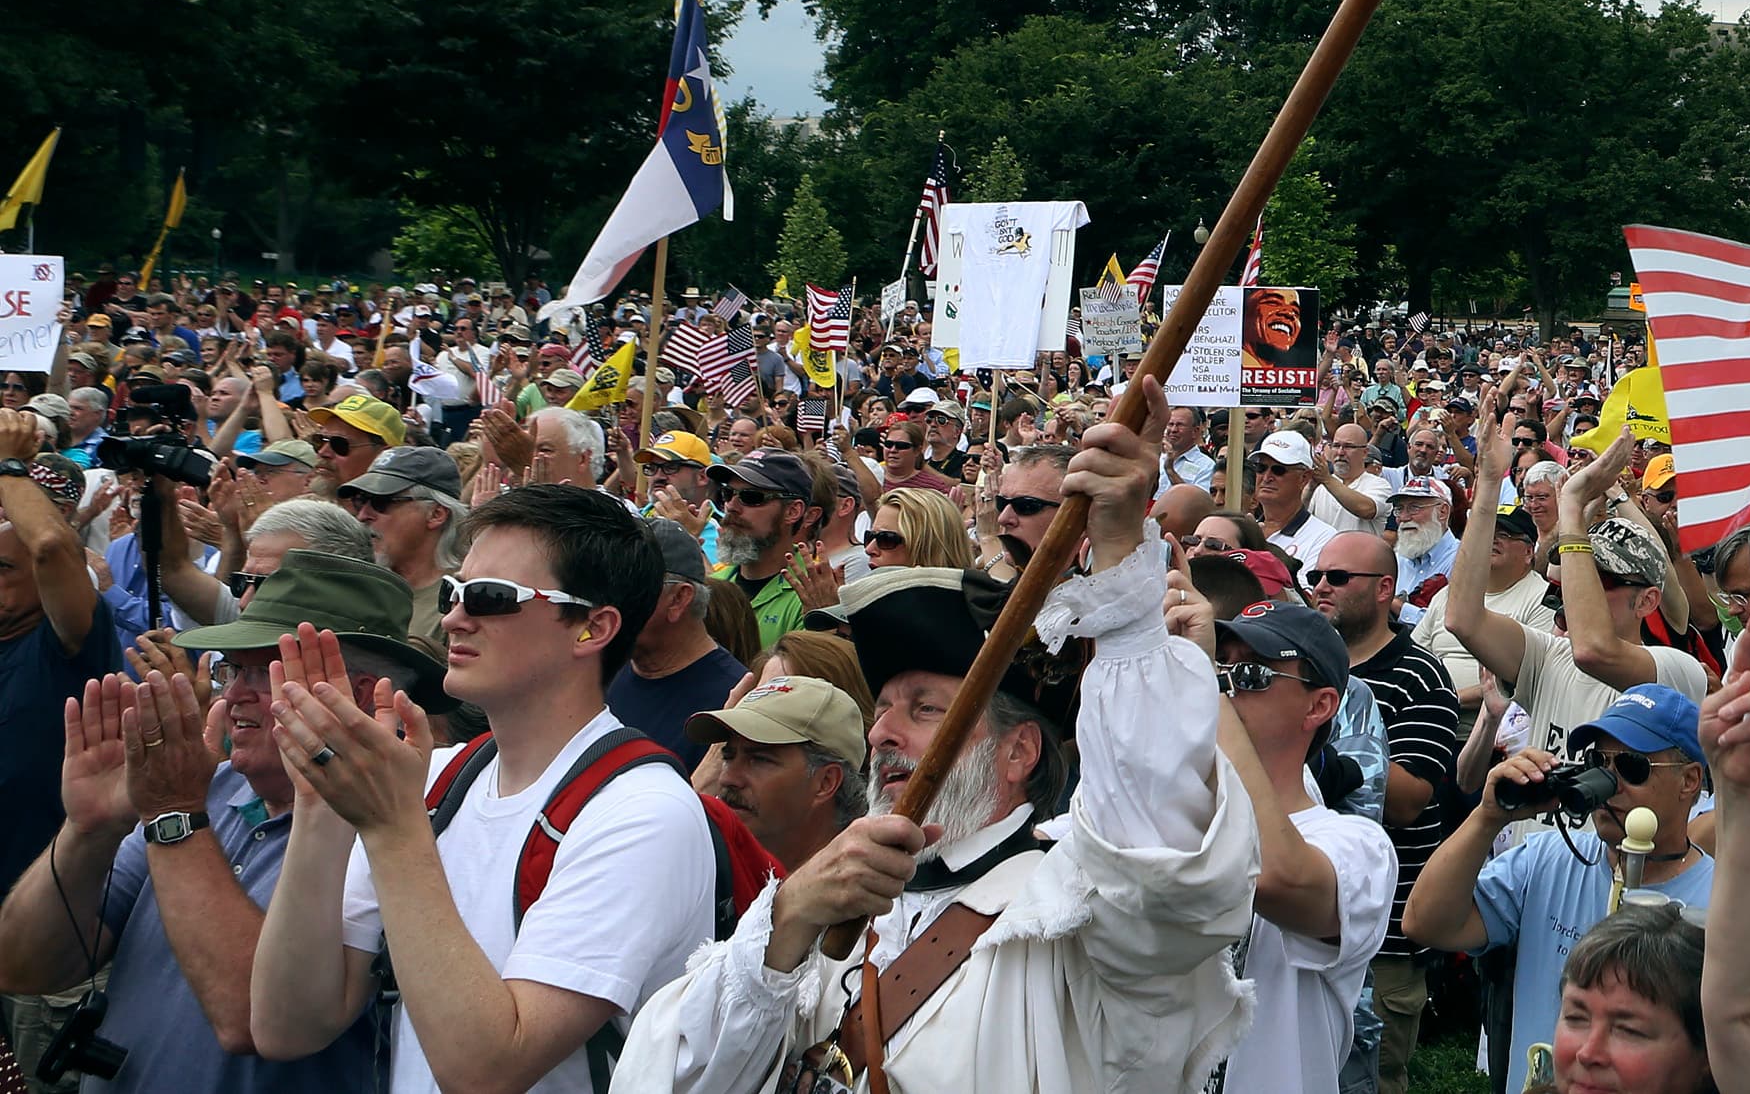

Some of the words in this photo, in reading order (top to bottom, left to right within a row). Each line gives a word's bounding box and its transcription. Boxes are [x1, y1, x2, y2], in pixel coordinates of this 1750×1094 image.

[0, 290, 32, 318] SE
[1194, 335, 1235, 344] BENGHAZI
[1191, 356, 1225, 365] HOLDER
[1191, 366, 1210, 374] NSA
[1192, 374, 1231, 383] SEBELIUS
[1241, 369, 1316, 385] RESIST!
[1557, 944, 1569, 956] to
